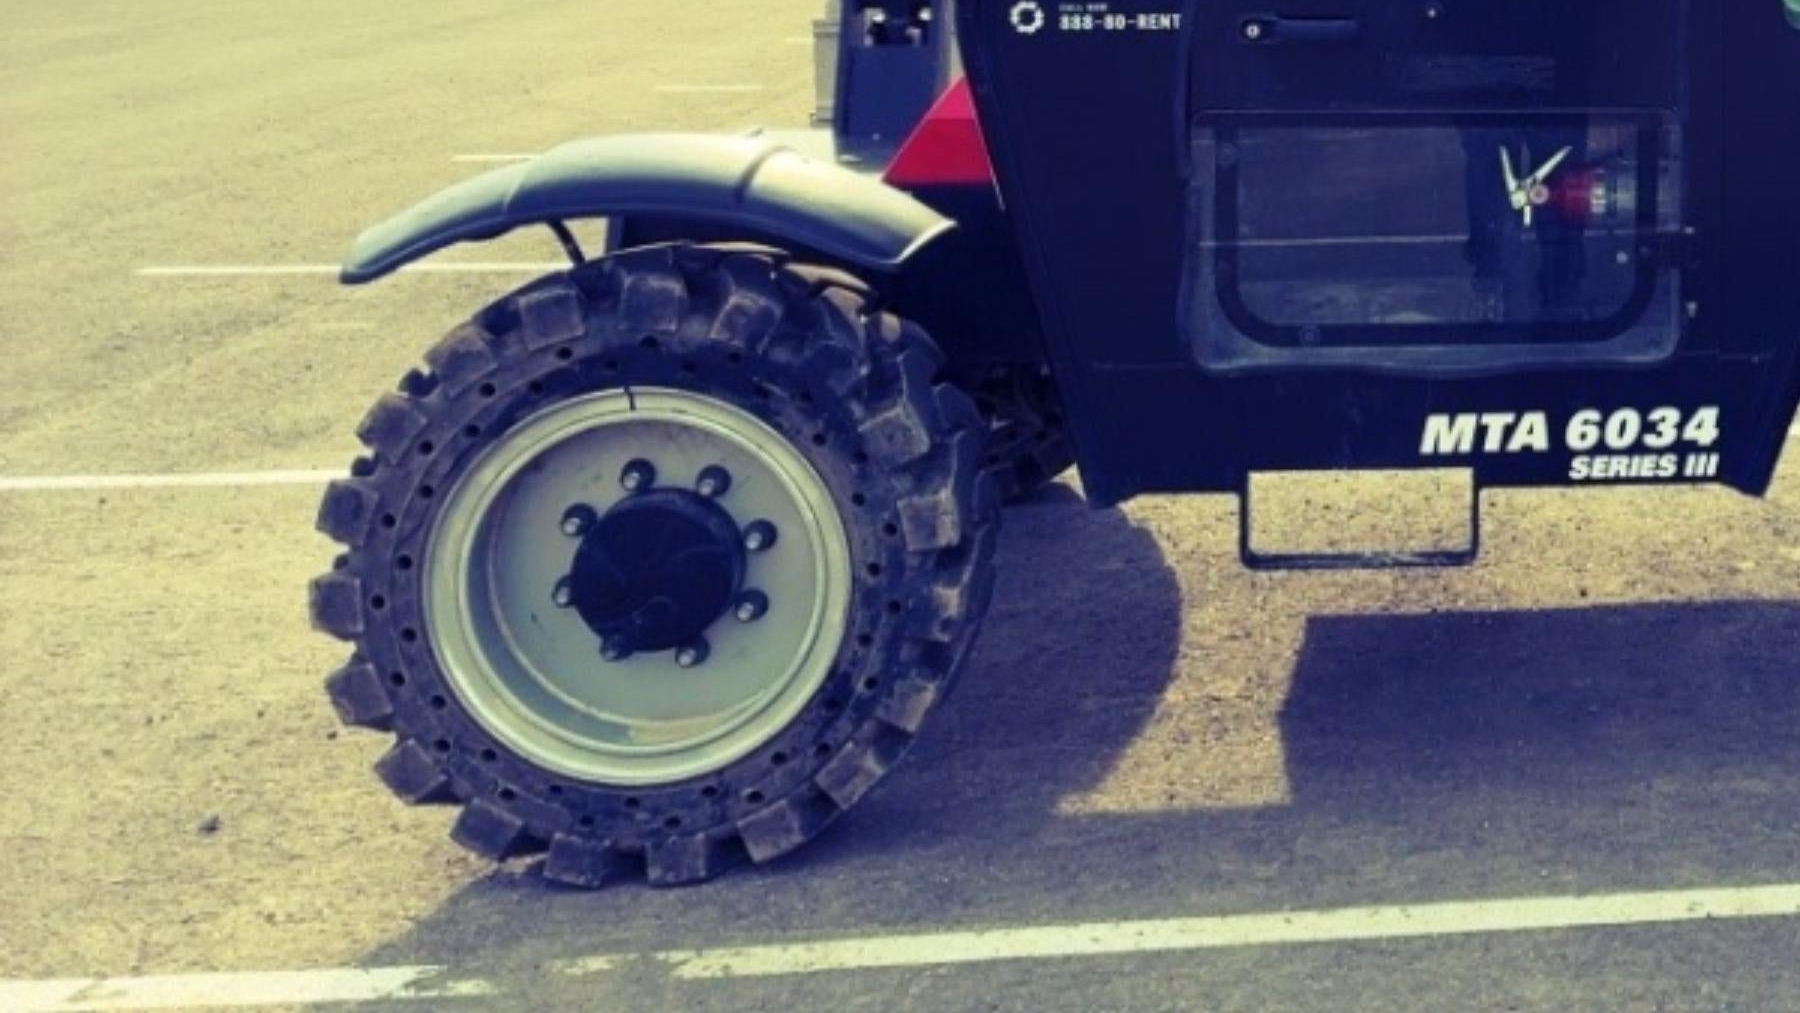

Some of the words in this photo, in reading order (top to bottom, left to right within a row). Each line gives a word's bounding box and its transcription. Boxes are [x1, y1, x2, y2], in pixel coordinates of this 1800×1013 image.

[1419, 411, 1549, 455] MTA
[1565, 406, 1719, 451] 6034
[1568, 453, 1678, 480] SERIES
[1683, 453, 1719, 477] III
